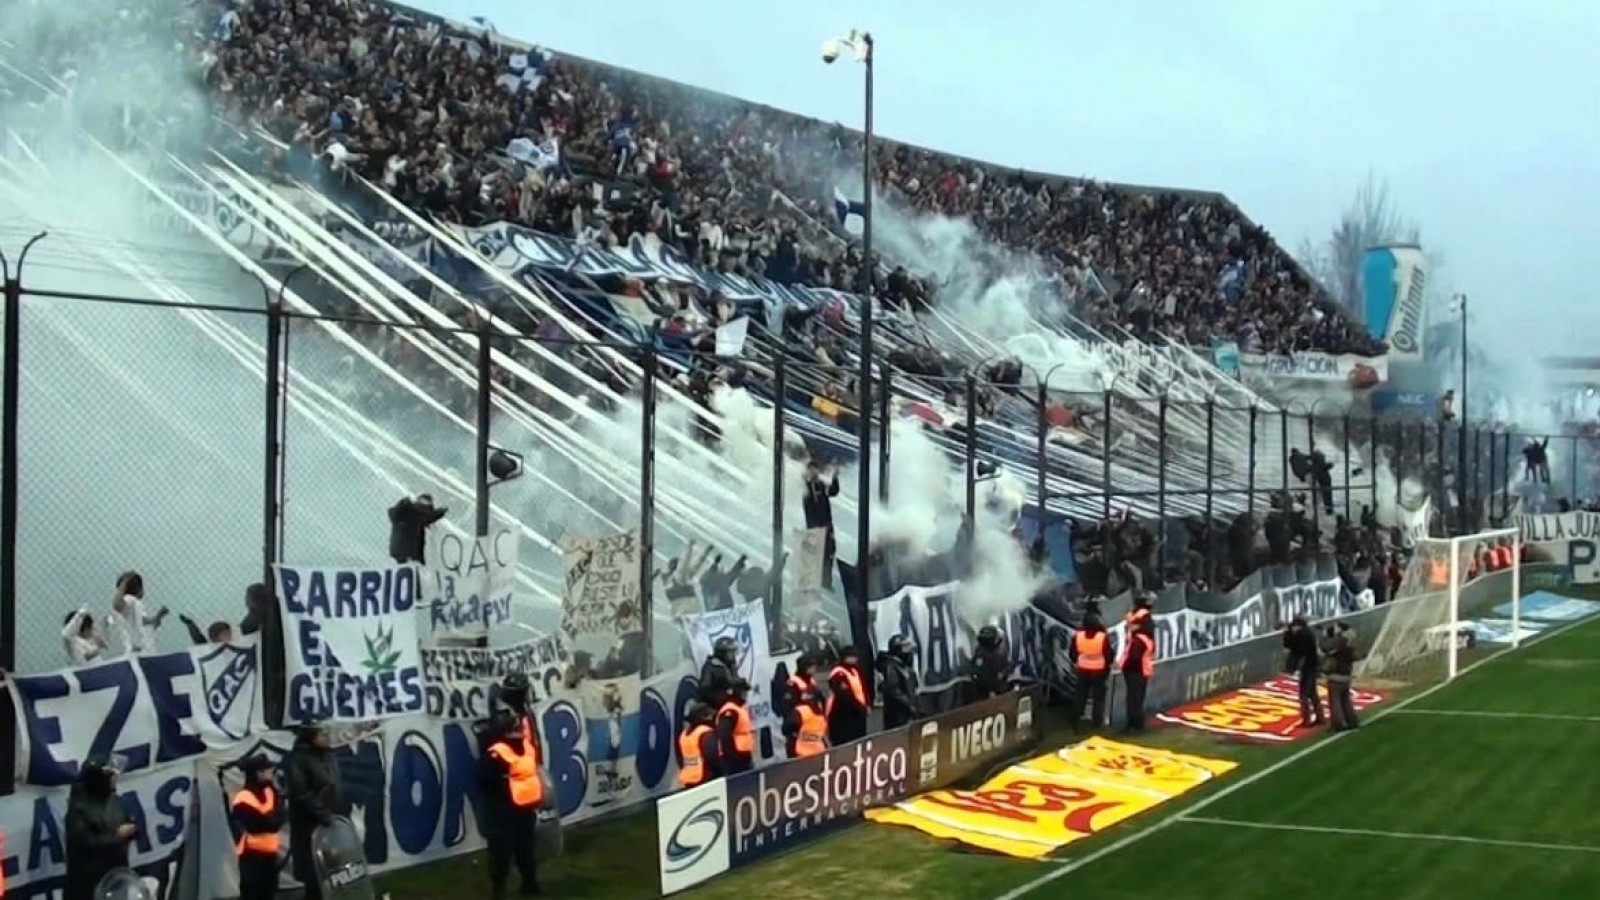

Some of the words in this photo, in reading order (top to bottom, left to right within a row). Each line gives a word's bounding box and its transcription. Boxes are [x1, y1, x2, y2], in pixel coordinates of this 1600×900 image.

[440, 529, 511, 577] QAC
[280, 567, 414, 615] BARRIO
[15, 651, 208, 786] EZE
[290, 667, 423, 723] GÜEMES
[950, 713, 1005, 764] IVECO
[742, 782, 907, 851] INTERNACIONAL
